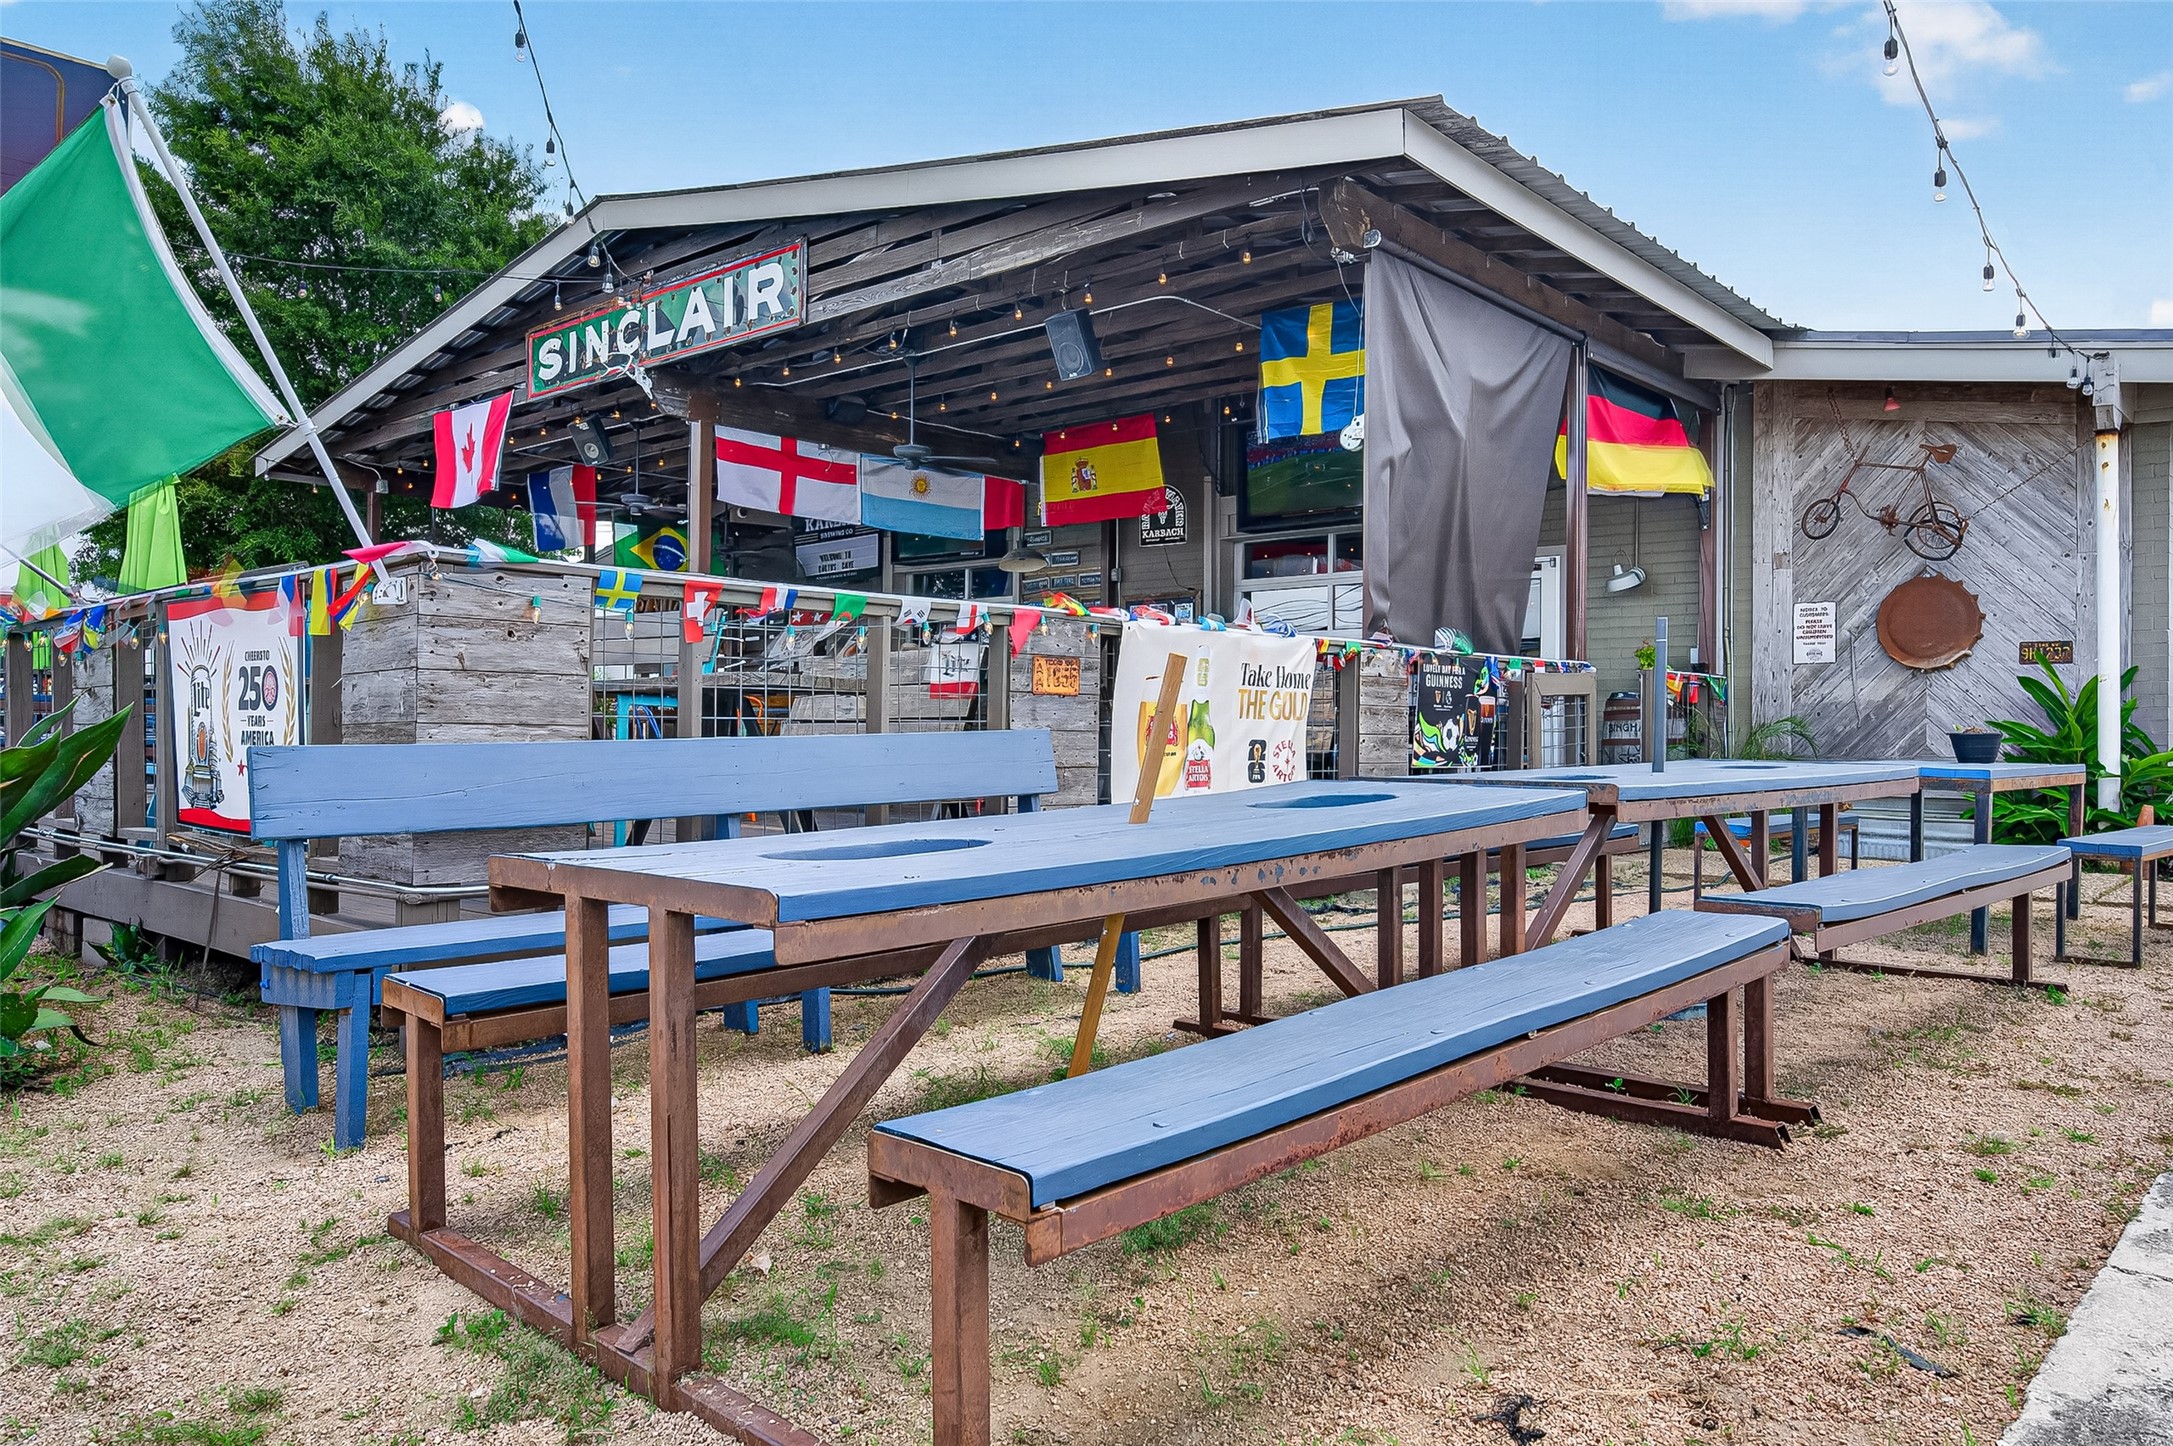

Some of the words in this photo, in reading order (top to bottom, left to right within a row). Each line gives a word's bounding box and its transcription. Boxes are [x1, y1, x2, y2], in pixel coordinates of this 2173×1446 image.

[538, 263, 784, 381] SINCLAIR
[1142, 528, 1184, 539] KARBACH
[1241, 662, 1273, 688] Take
[1276, 665, 1311, 690] Home
[1423, 663, 1441, 673] LOVELY
[1441, 665, 1452, 674] DAY
[238, 664, 279, 711] 250
[1426, 674, 1462, 688] GUINNESS
[192, 681, 210, 717] Lite
[1238, 688, 1268, 720] THE
[1269, 690, 1308, 721] GOLD
[247, 714, 266, 727] YEARS
[240, 730, 275, 746] AMERICA
[1188, 765, 1209, 774] STELLA
[1188, 773, 1209, 782] ARTOIS
